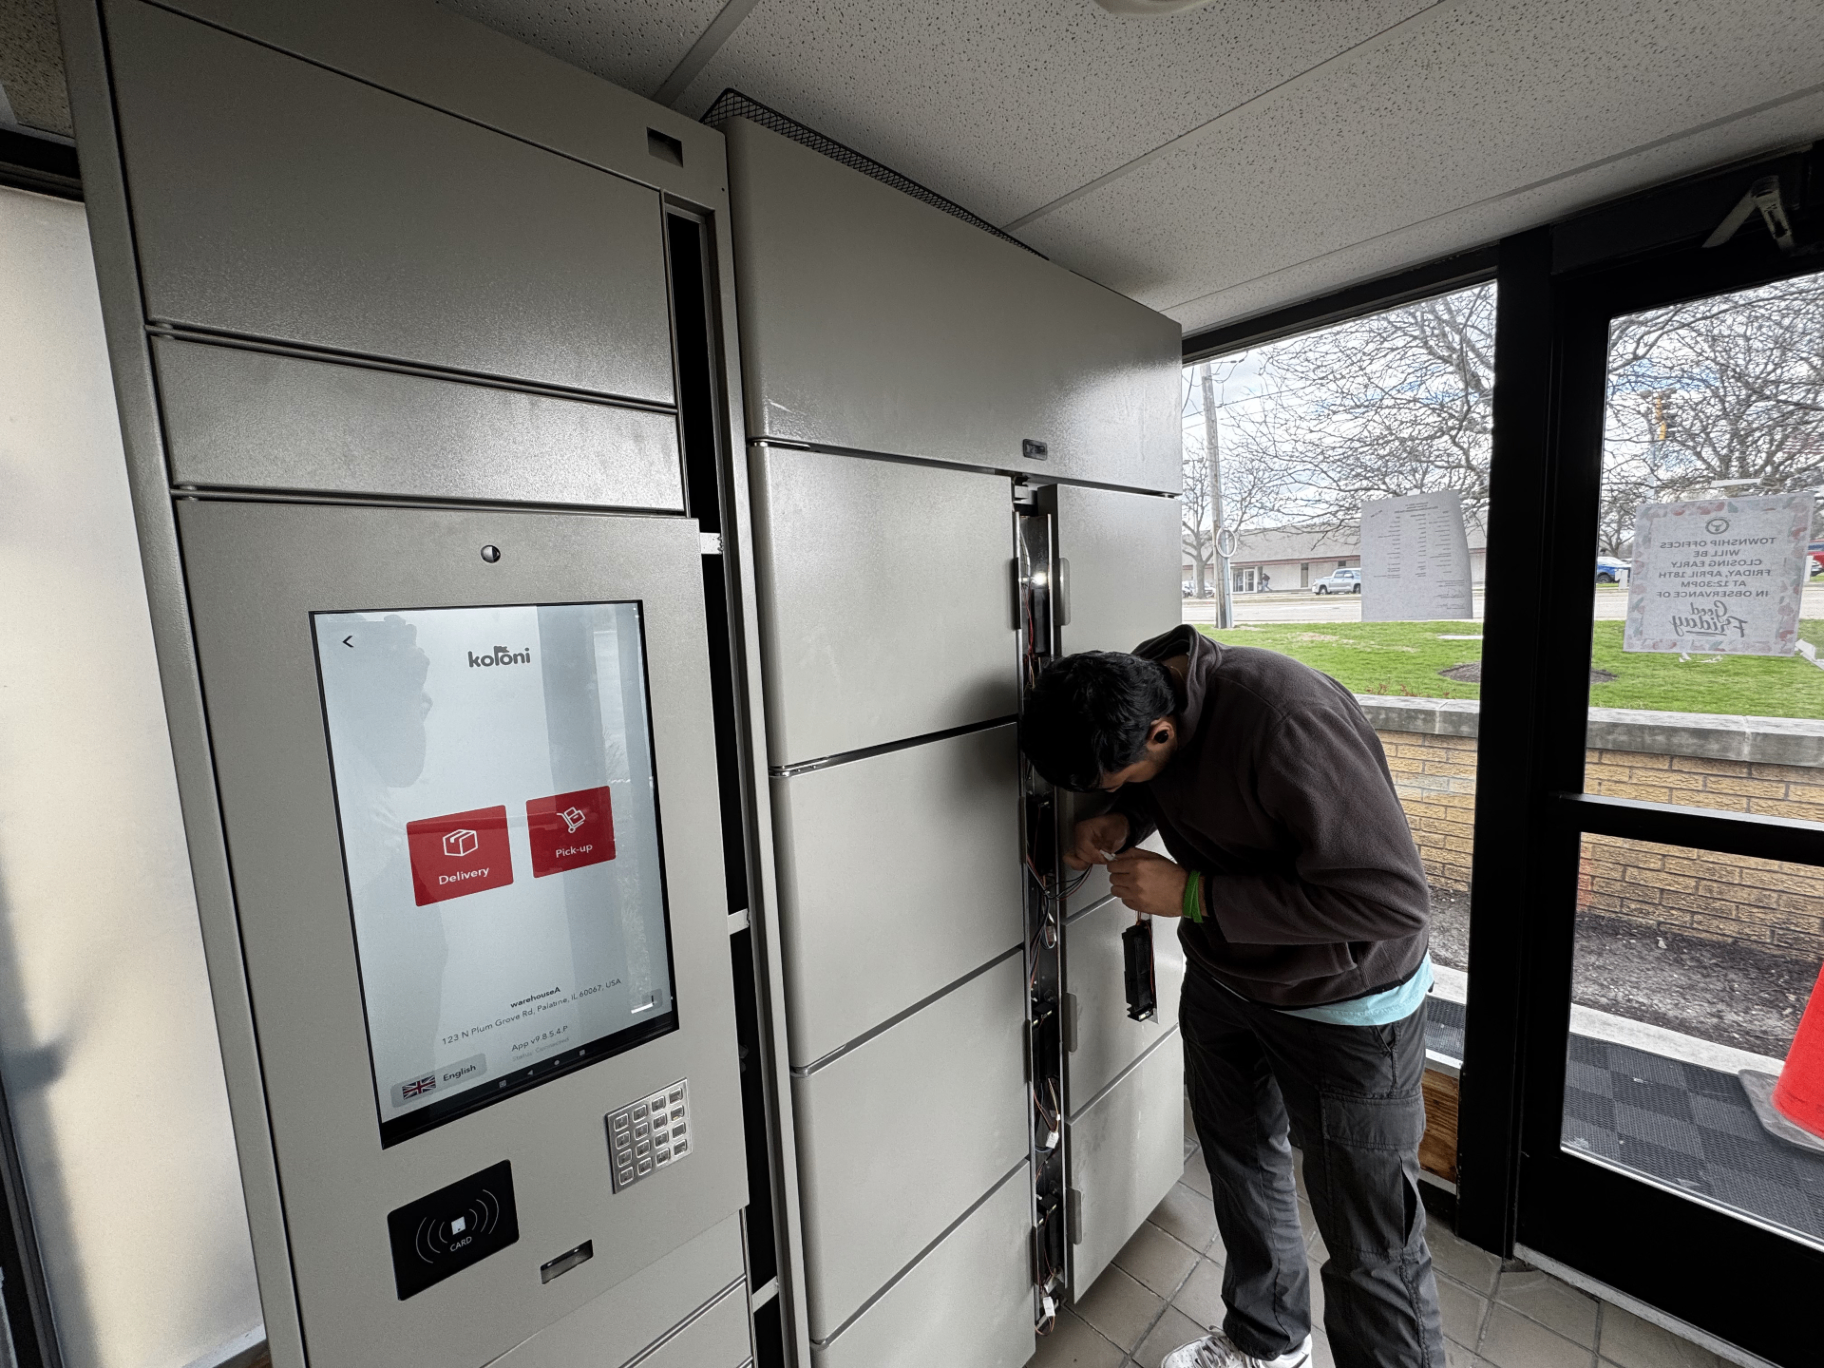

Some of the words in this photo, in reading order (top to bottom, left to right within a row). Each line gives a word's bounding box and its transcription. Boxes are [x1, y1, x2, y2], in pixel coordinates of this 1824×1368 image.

[468, 645, 530, 667] koloni
[555, 844, 593, 858] Pick-up
[438, 867, 489, 885] Delivery
[510, 986, 561, 1008] warehouseA
[442, 1033, 459, 1045] 123
[461, 1030, 469, 1038] N
[471, 1023, 493, 1035] Plum
[494, 1014, 520, 1027] Grove
[522, 1007, 535, 1018] Rd,
[537, 997, 569, 1013] Palatine,
[605, 978, 621, 988] USA
[511, 1041, 529, 1051] App
[443, 1064, 476, 1082] English
[450, 1236, 472, 1251] CARD
